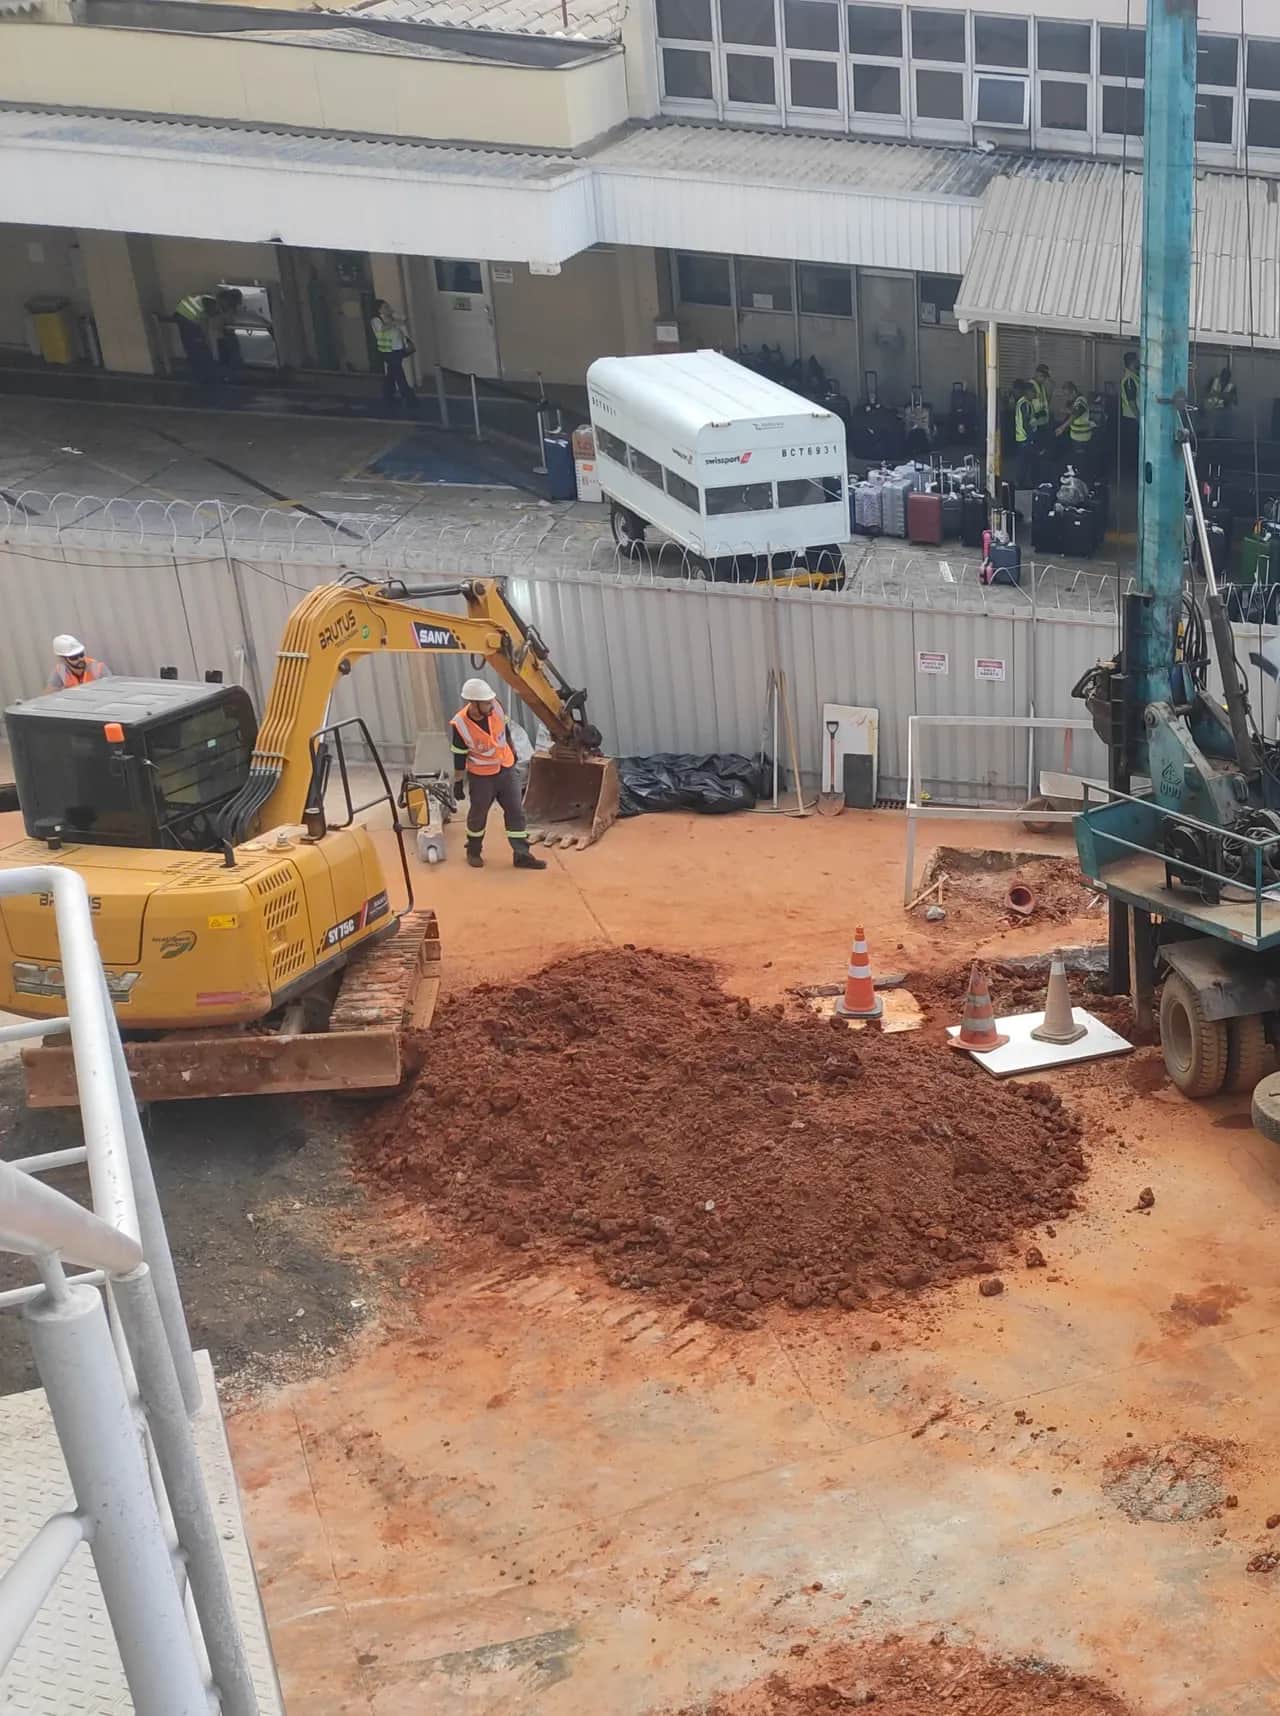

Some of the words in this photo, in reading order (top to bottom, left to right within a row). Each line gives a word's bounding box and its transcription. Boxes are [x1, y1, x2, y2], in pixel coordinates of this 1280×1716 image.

[705, 455, 741, 464] swissport
[318, 609, 357, 649] BRUTUS
[419, 630, 450, 645] SANY
